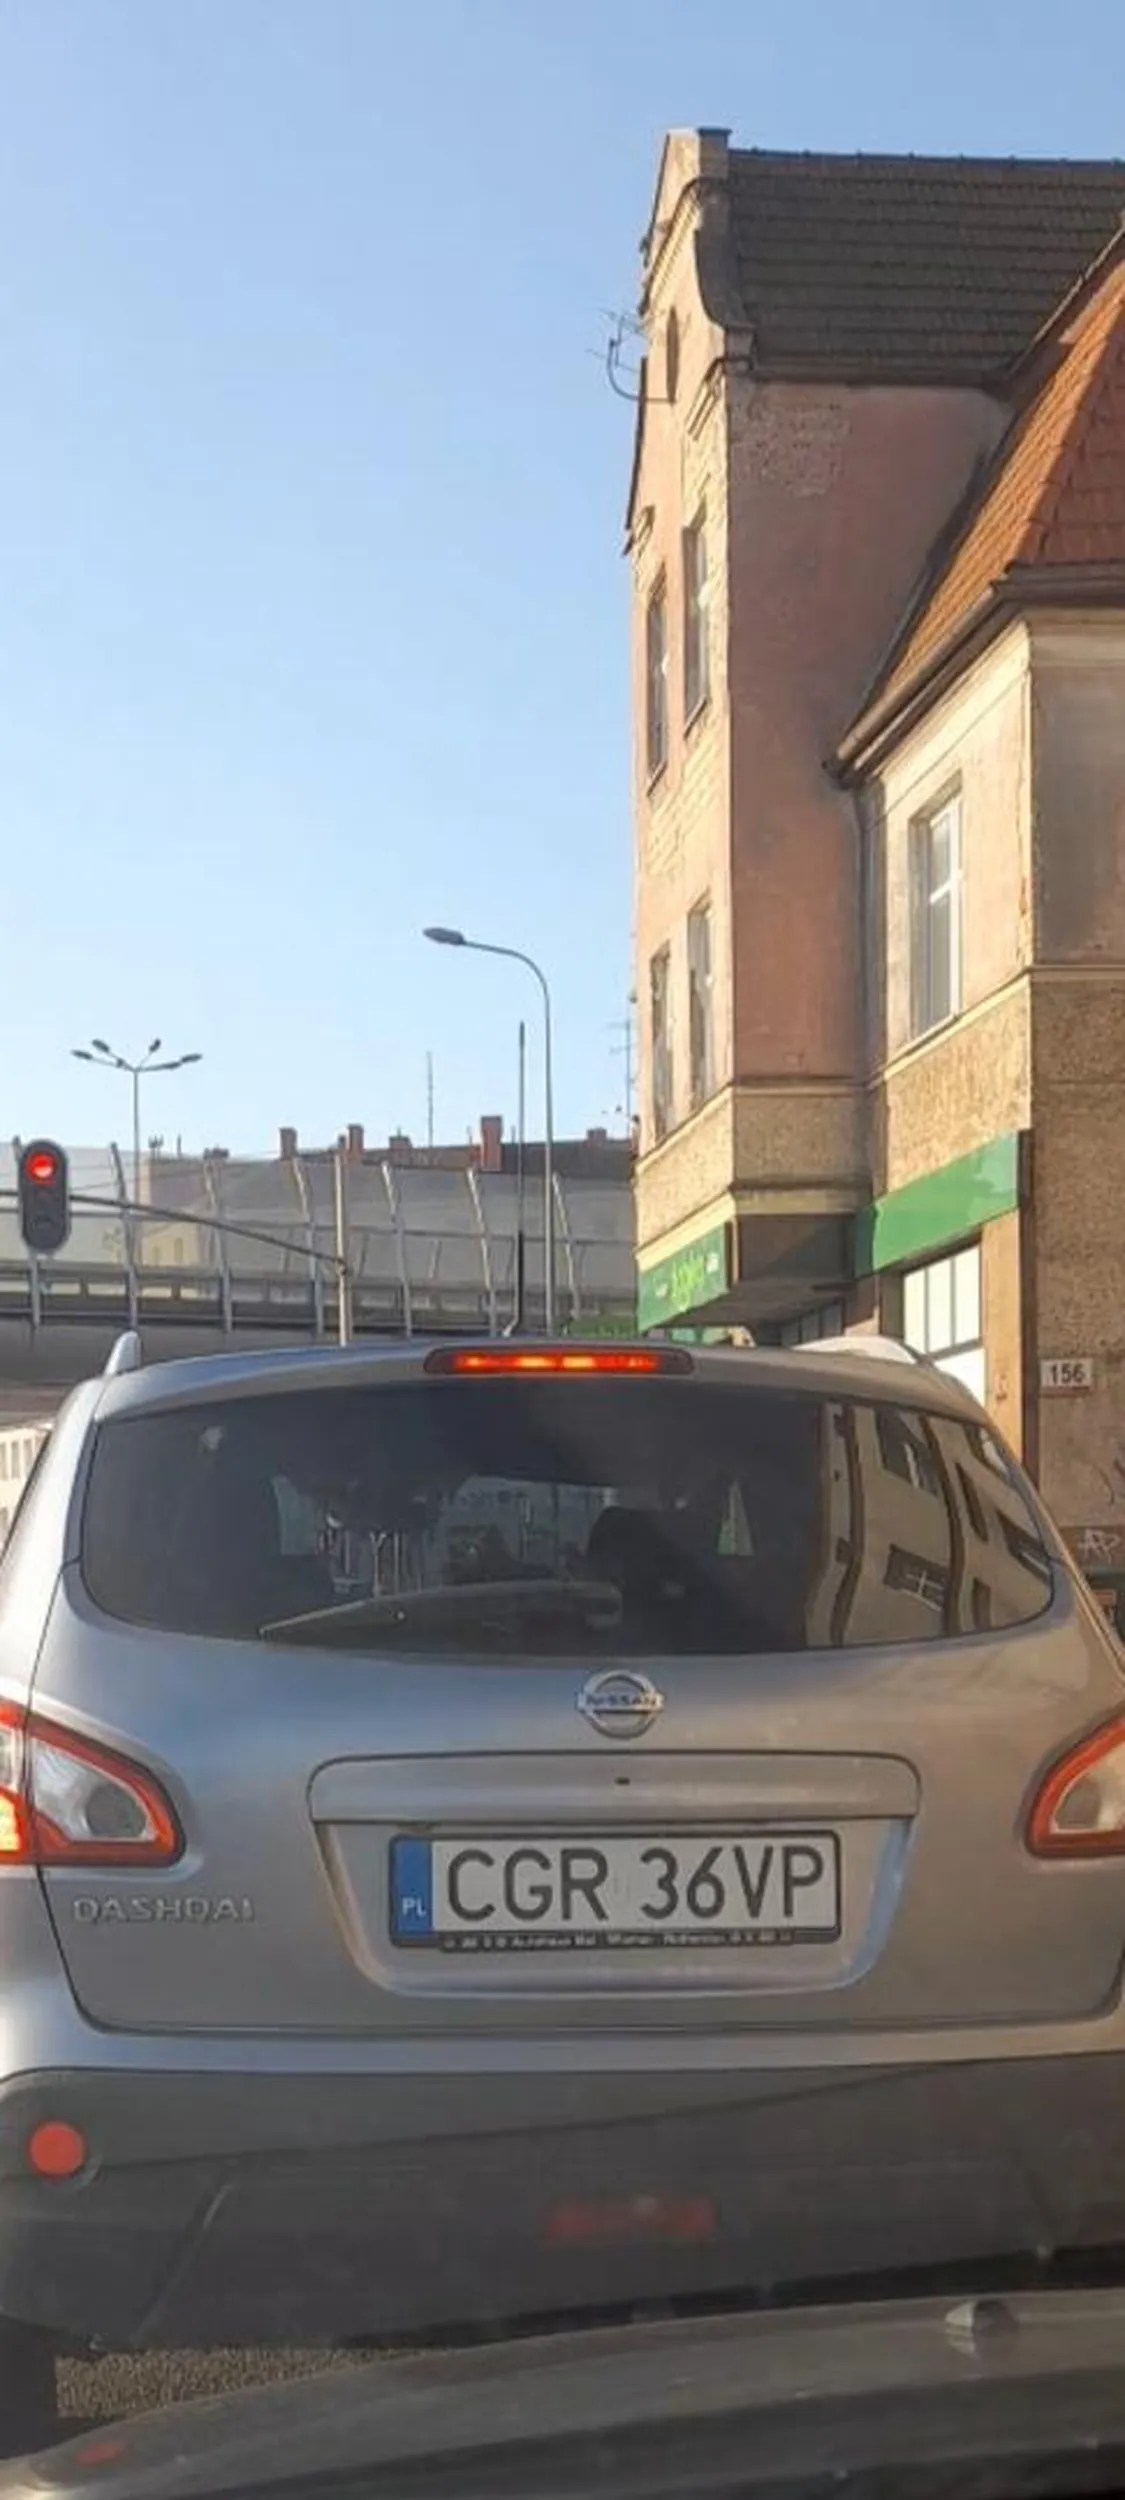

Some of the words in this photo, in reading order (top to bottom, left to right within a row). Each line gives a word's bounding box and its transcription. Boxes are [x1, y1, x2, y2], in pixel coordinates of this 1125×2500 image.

[1050, 1363, 1087, 1384] 156
[447, 1847, 609, 1922] CGR
[640, 1845, 824, 1919] 36VP
[402, 1897, 426, 1917] PL
